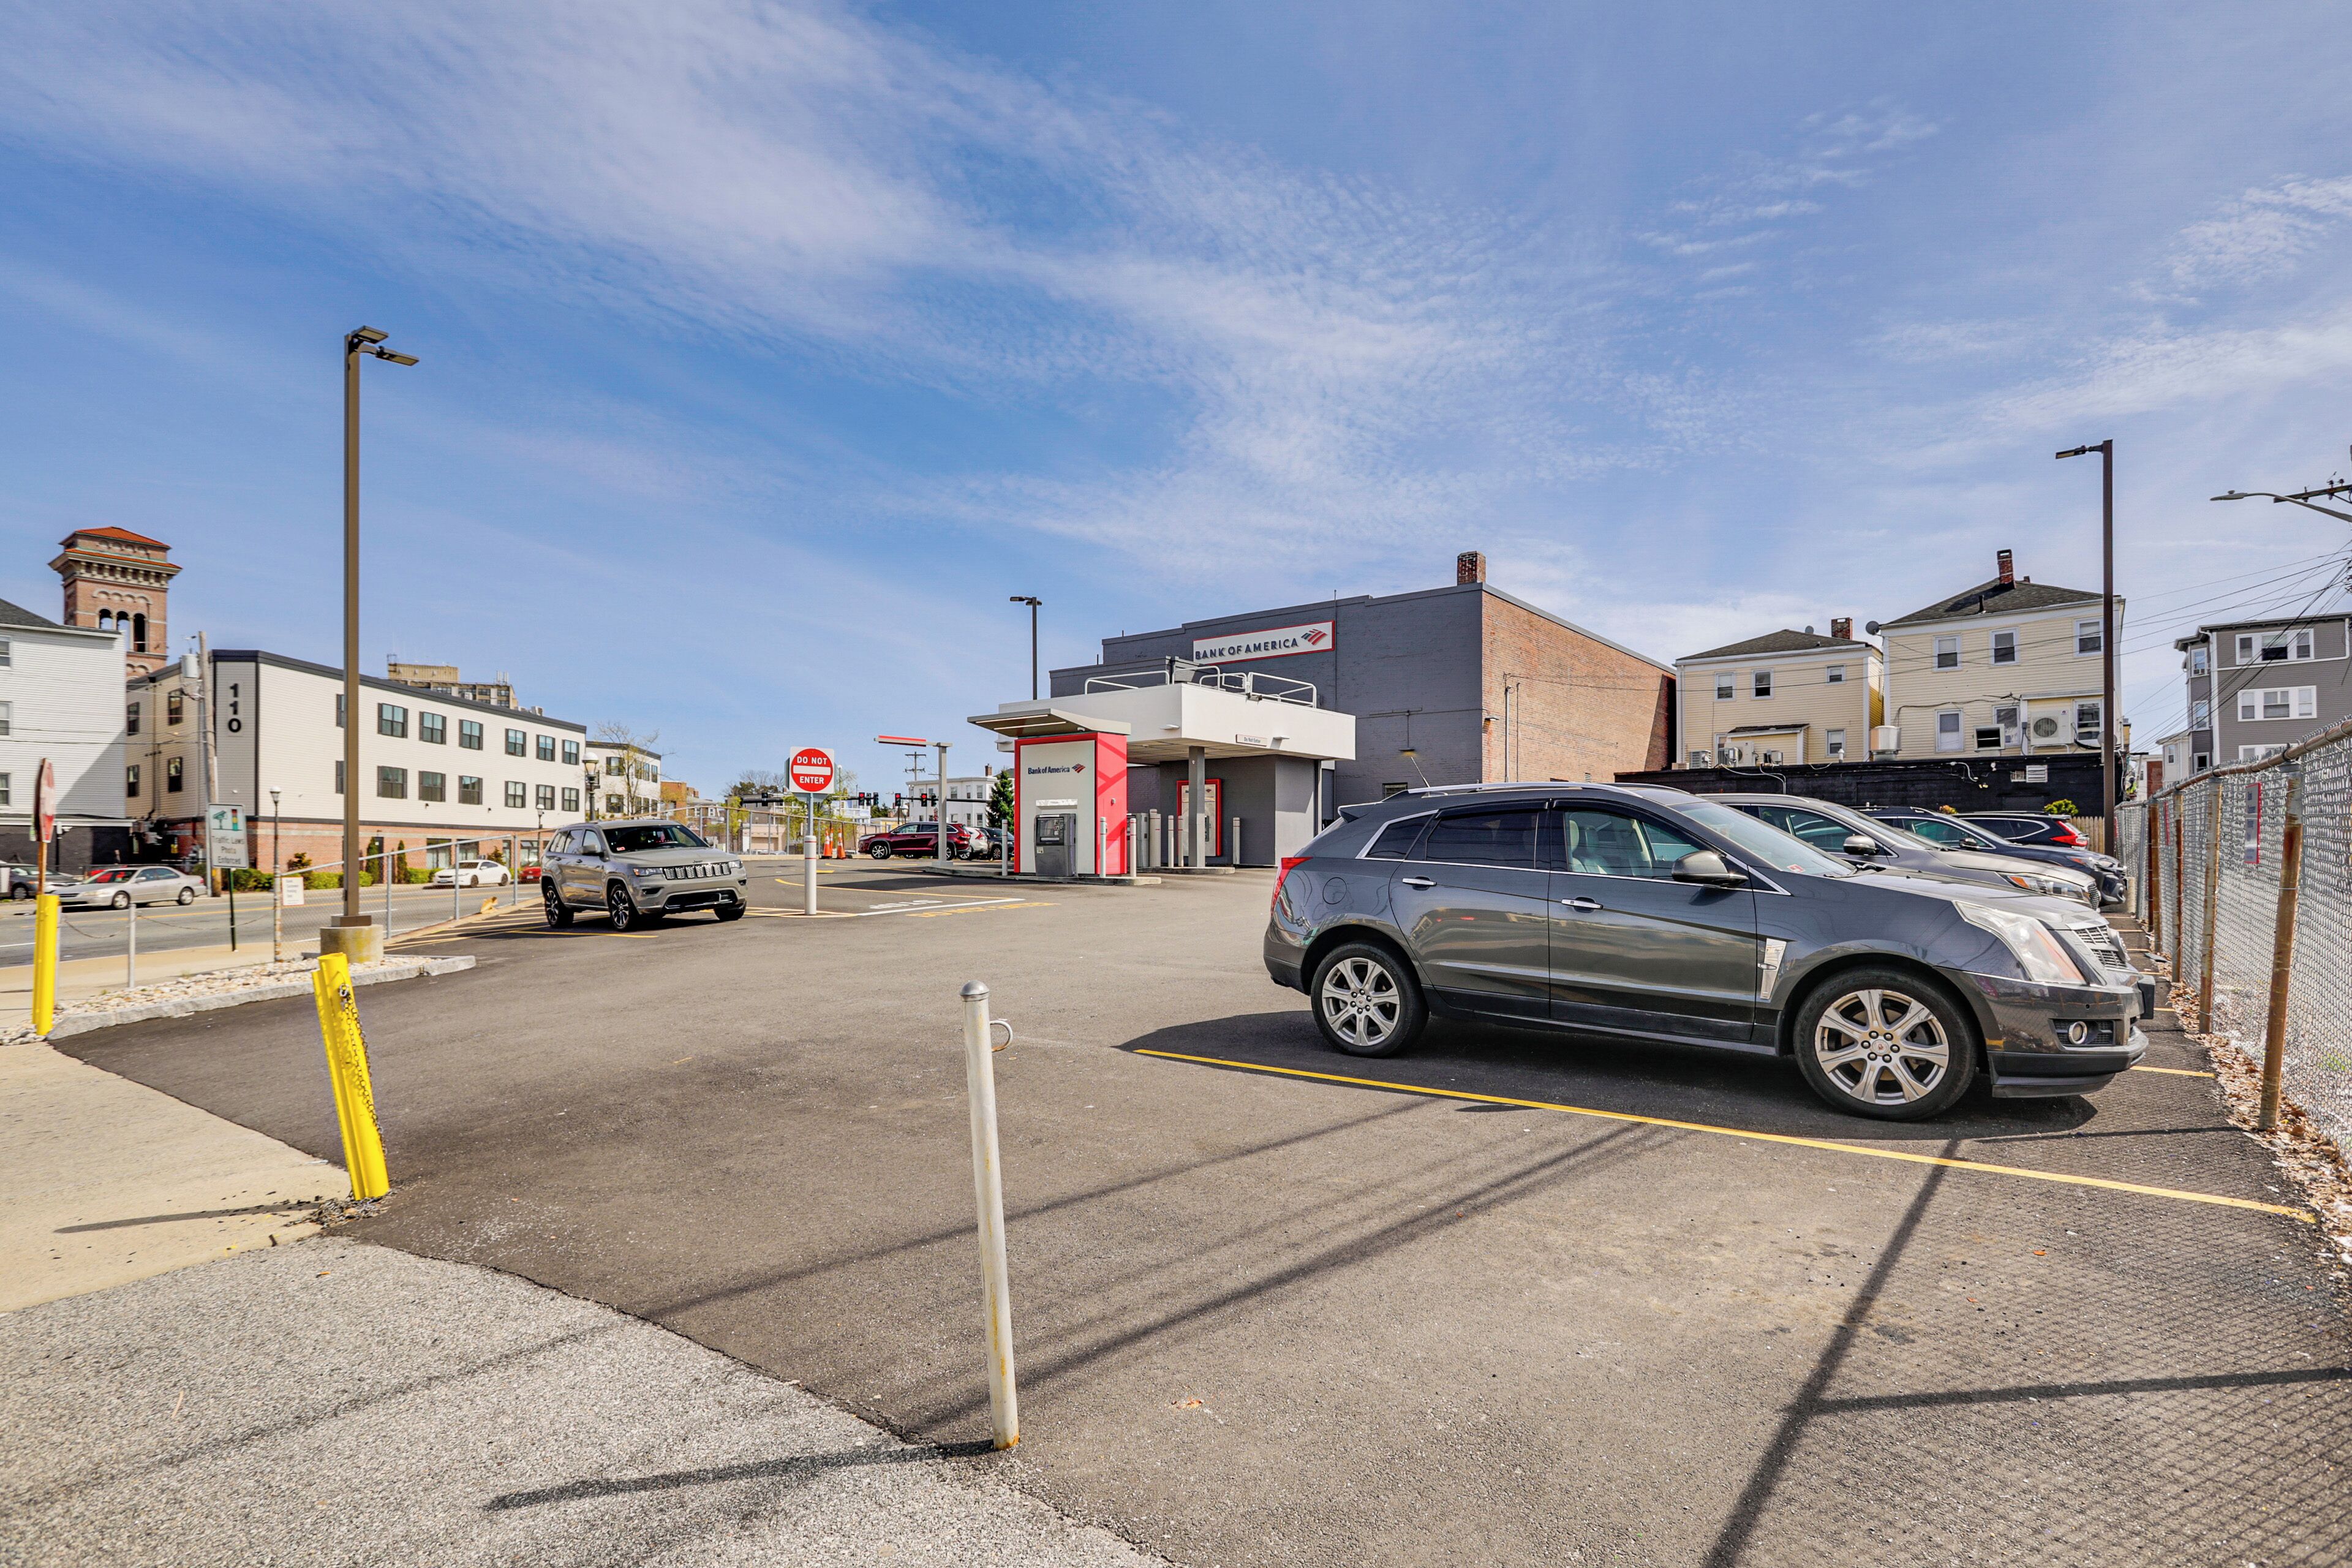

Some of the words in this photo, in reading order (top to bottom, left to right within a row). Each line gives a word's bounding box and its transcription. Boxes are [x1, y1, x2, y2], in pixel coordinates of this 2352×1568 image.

[1195, 647, 1225, 660] BANK
[1227, 644, 1242, 656] OF
[1245, 638, 1298, 654] AMERICA
[228, 683, 241, 733] 110
[797, 756, 808, 764] DO
